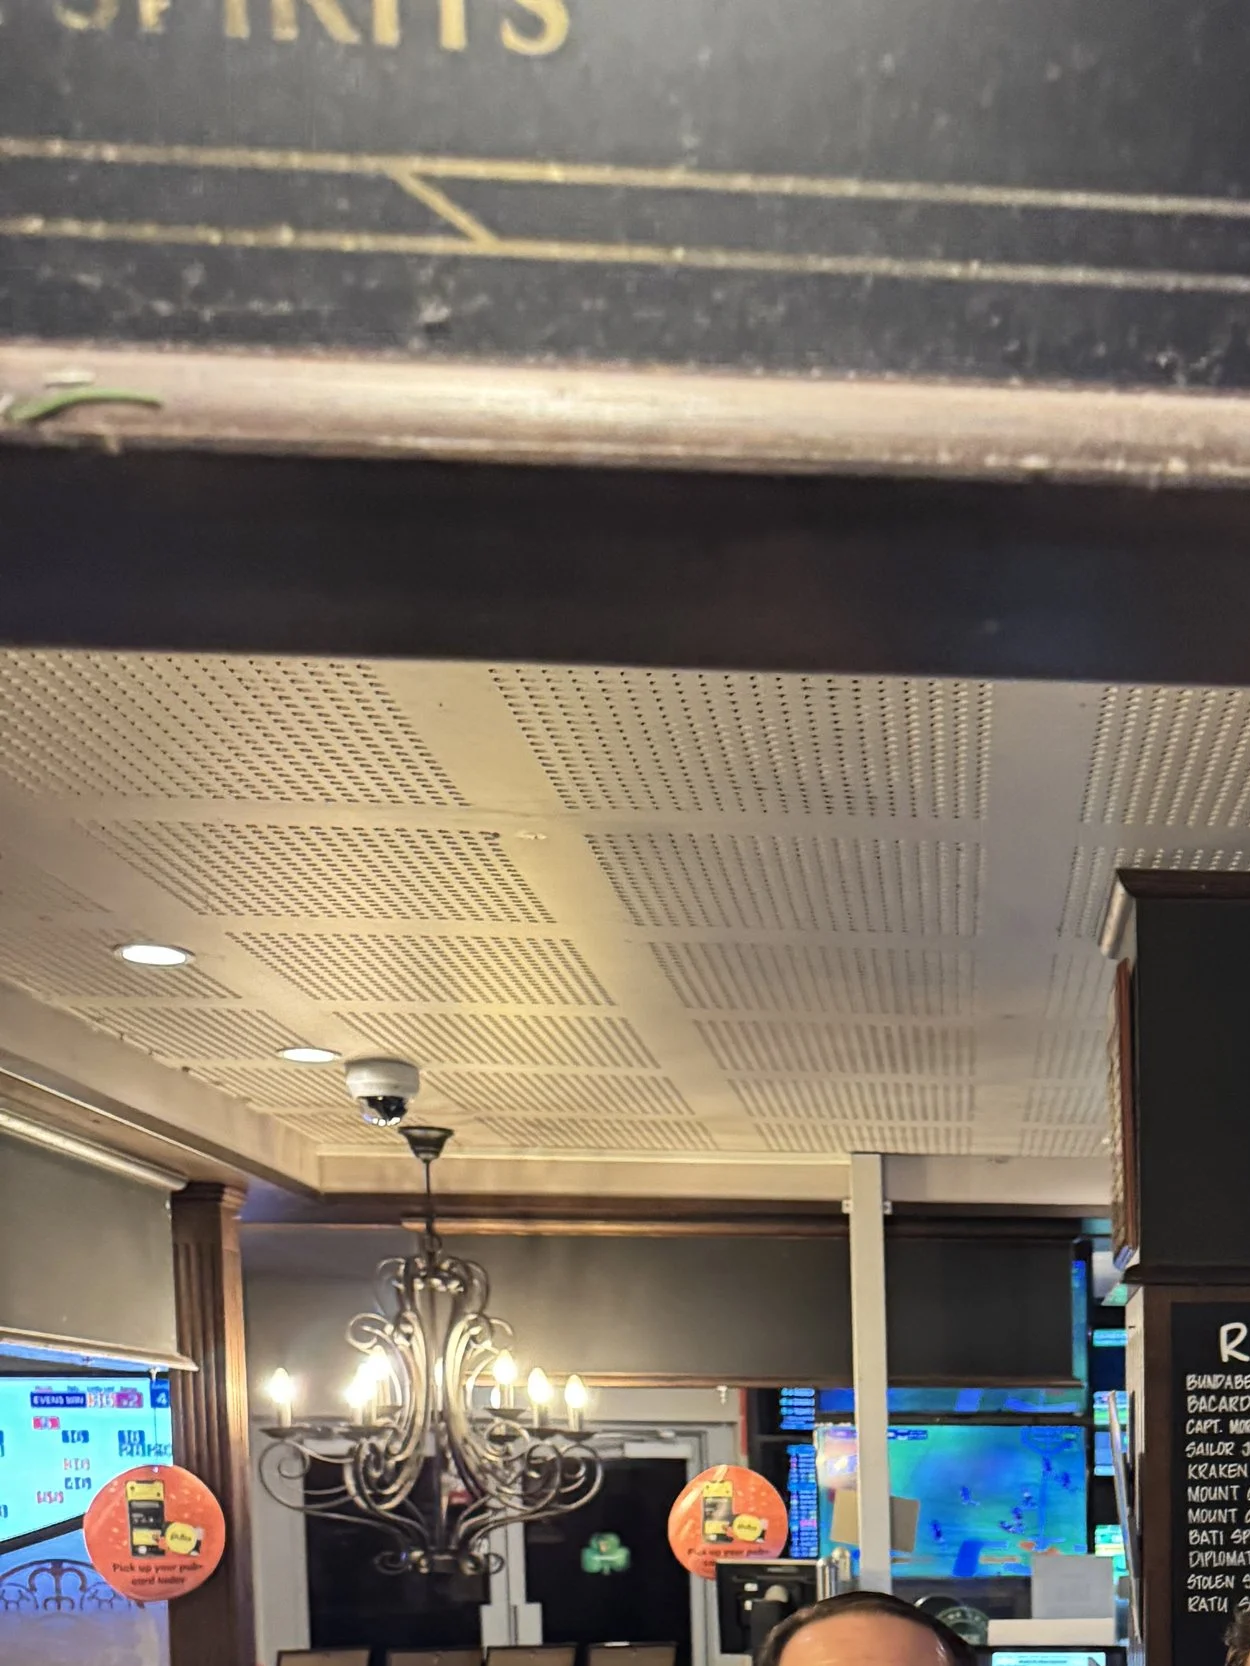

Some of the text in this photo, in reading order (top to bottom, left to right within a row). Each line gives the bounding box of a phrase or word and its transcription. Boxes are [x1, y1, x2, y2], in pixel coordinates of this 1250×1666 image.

[1186, 1418, 1223, 1434] CAPT.
[1185, 1440, 1234, 1458] SAILOR
[1188, 1463, 1248, 1480] KRAKEN
[1188, 1485, 1241, 1501] MOUNT
[1188, 1507, 1238, 1524] MOUNT
[1189, 1529, 1224, 1545] BATI
[1187, 1574, 1235, 1590] STOLEN
[1188, 1595, 1228, 1613] RATU
